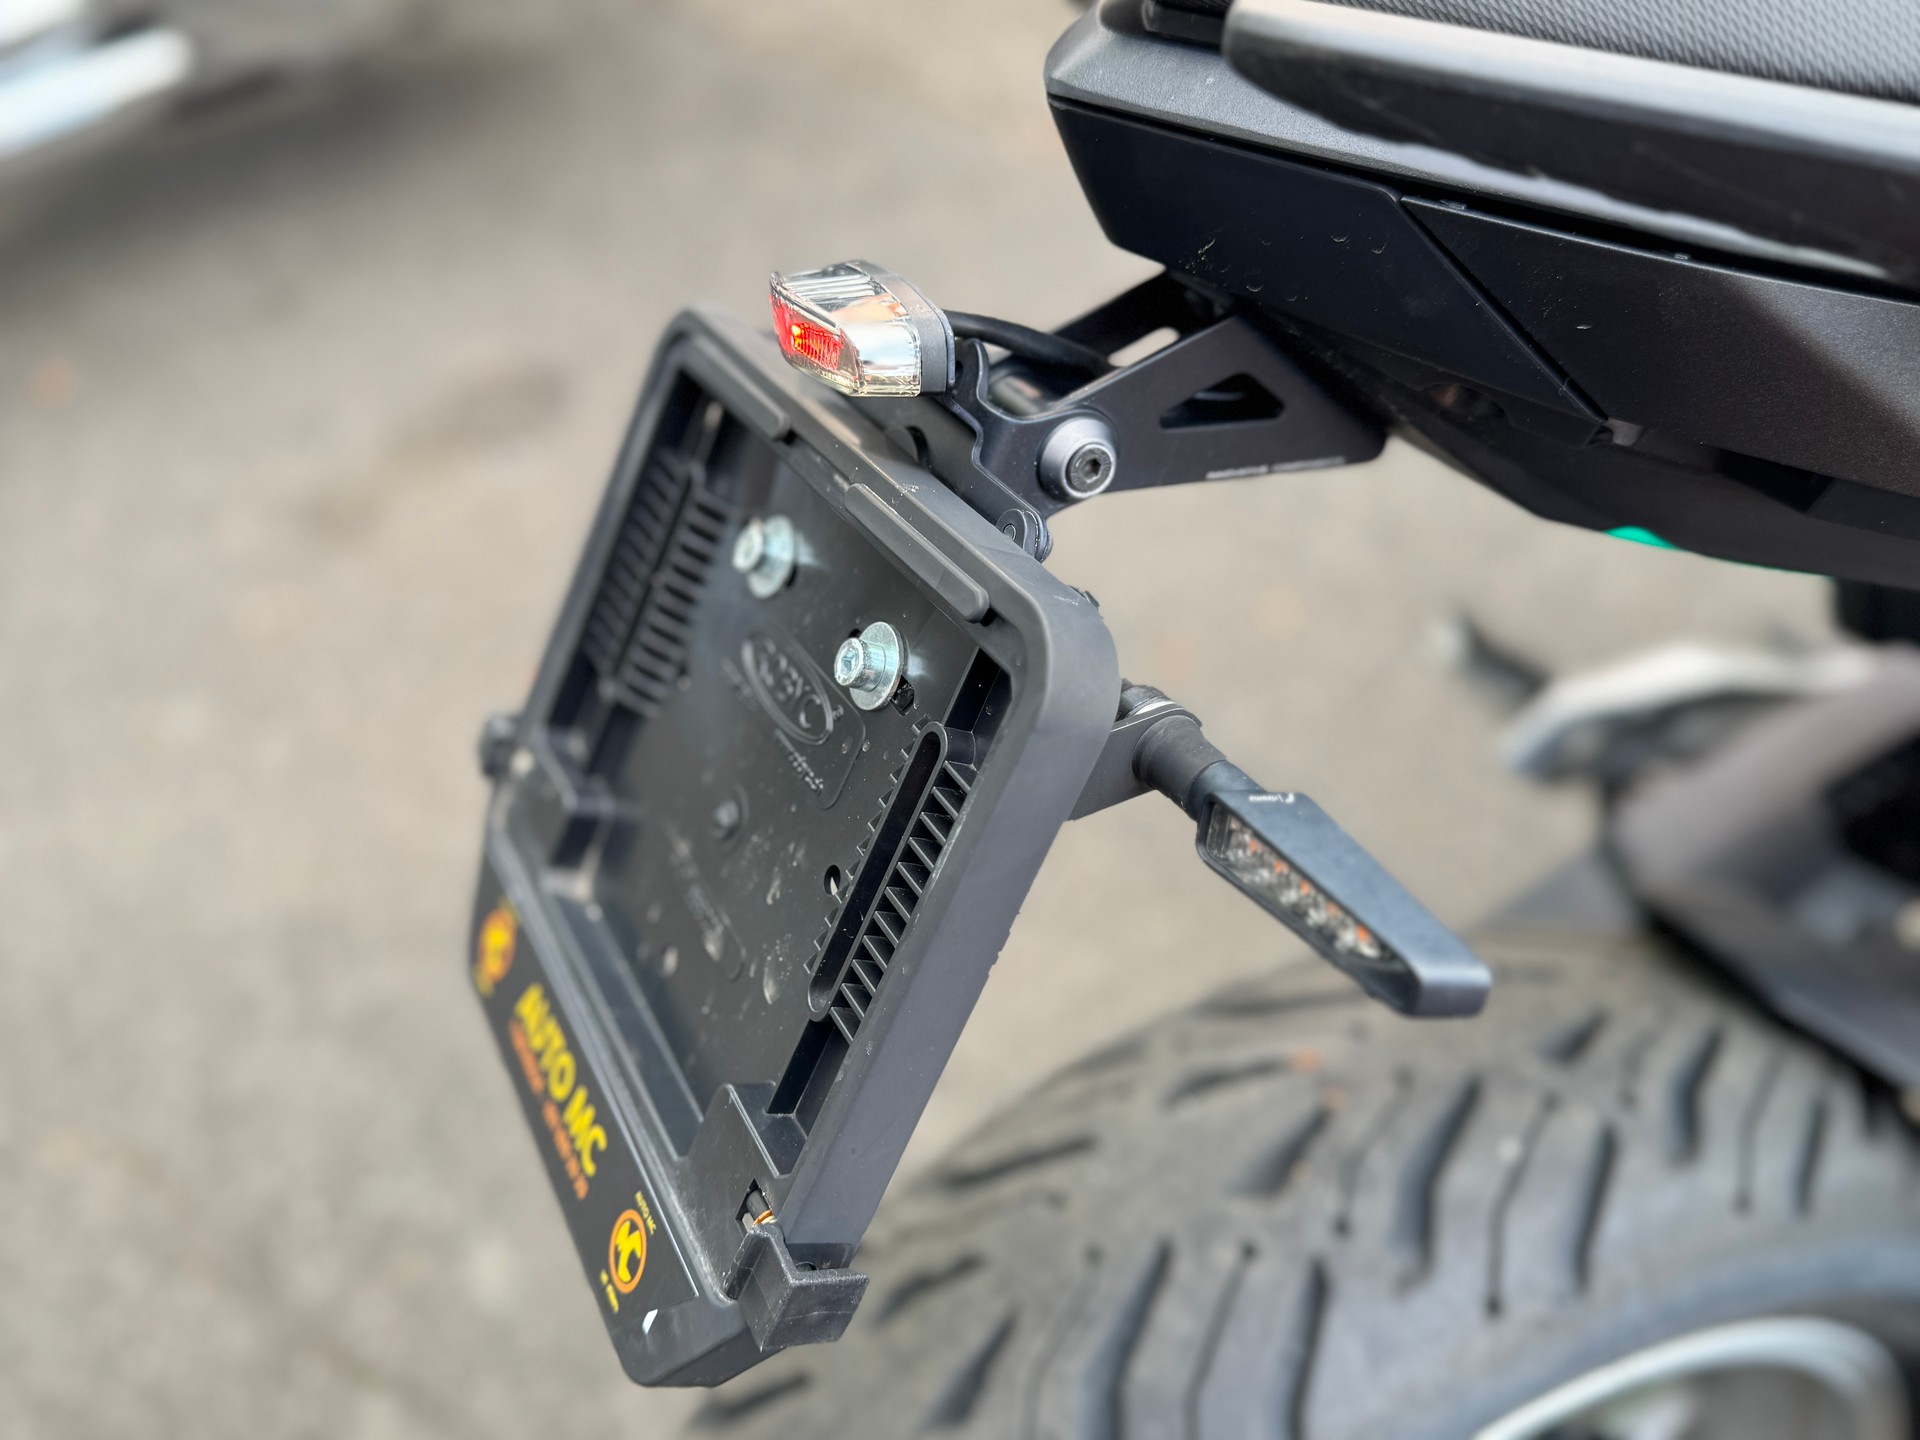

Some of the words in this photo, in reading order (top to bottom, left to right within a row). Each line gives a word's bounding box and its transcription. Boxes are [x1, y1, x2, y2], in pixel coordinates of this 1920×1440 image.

[515, 985, 577, 1101] AUTO
[562, 1086, 608, 1177] MC
[635, 1190, 650, 1220] AUTO
